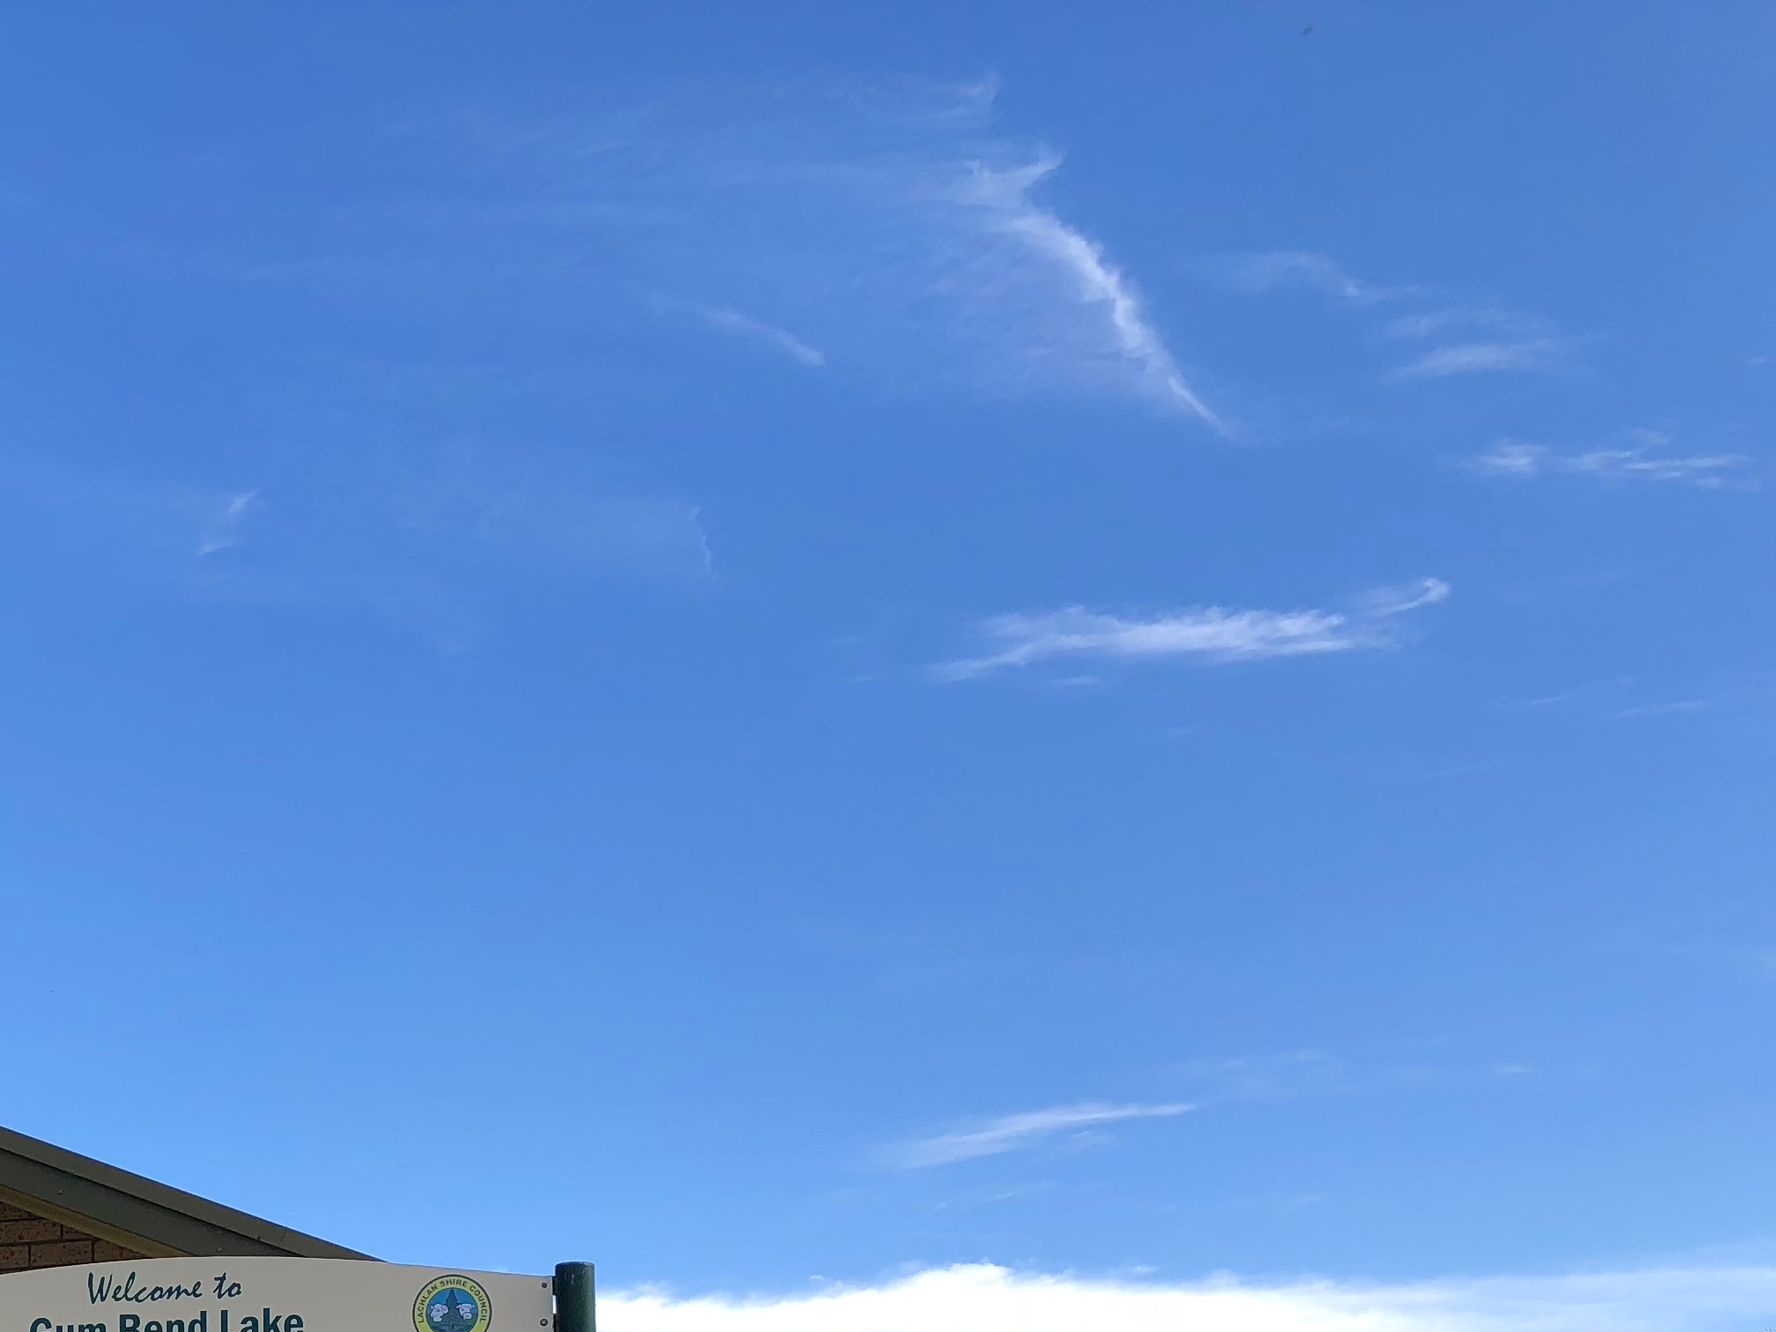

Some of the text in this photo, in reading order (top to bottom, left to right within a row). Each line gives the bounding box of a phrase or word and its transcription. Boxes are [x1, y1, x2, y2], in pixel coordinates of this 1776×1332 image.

[87, 1271, 242, 1305] Welcome to
[416, 1278, 488, 1324] LACHLAN SHIRE COUNCIL
